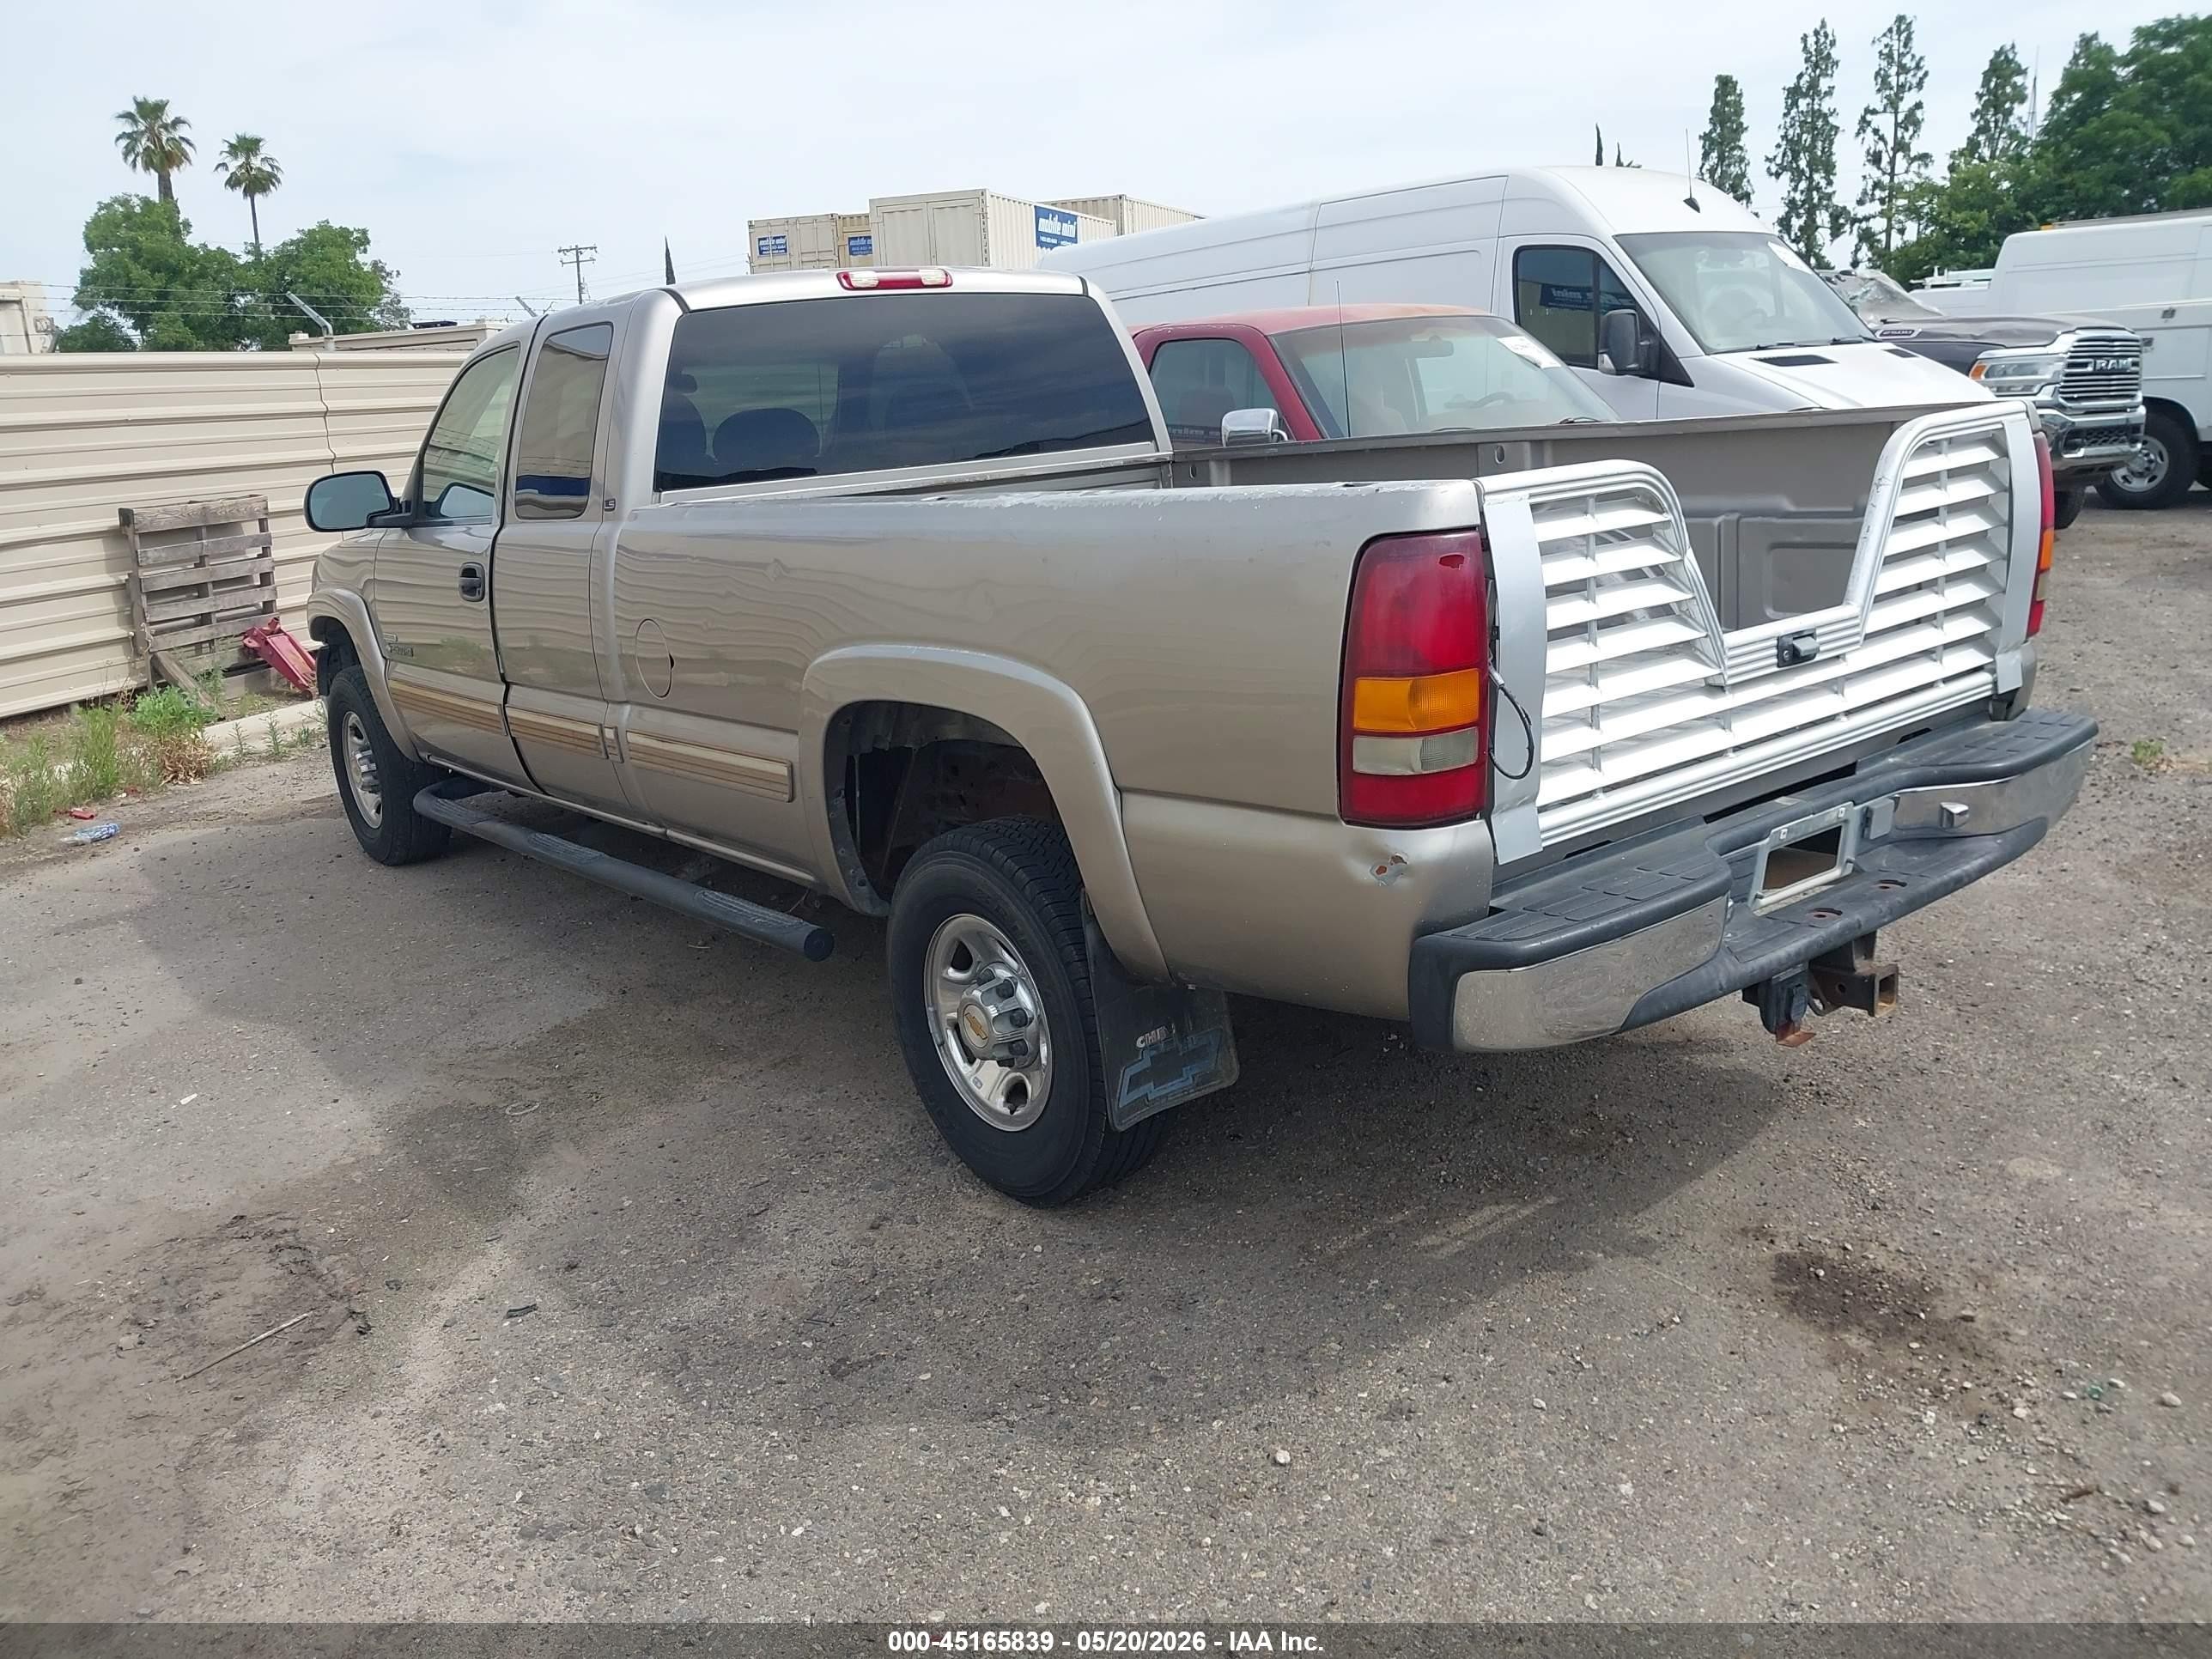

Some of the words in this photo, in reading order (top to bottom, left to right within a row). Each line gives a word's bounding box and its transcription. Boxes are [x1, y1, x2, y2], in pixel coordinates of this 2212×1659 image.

[1038, 213, 1061, 235] mobile
[1061, 220, 1076, 238] mini
[2095, 358, 2130, 370] RAM
